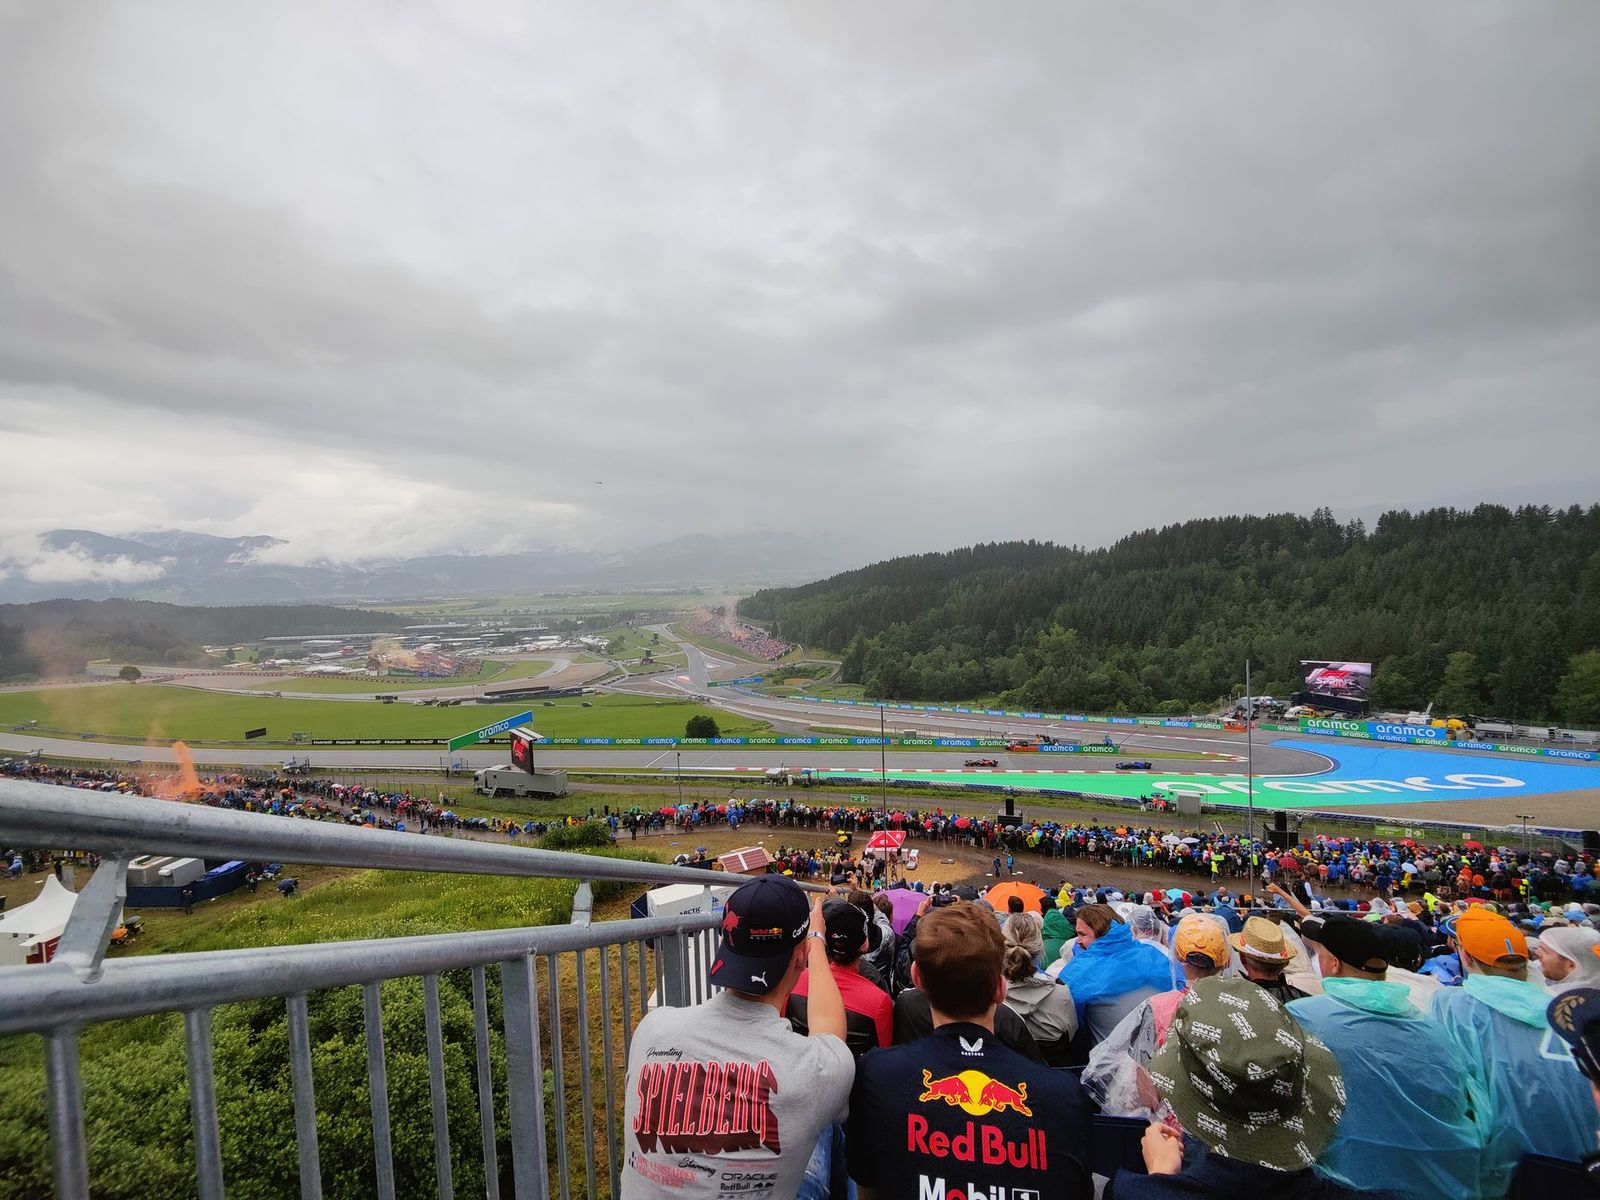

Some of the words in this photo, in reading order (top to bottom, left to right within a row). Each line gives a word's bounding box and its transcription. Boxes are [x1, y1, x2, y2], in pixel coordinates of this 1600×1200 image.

[1195, 722, 1221, 730] aramco
[1307, 719, 1359, 731] aramco
[478, 721, 510, 739] aramco
[1308, 728, 1335, 736] aramco
[1376, 724, 1436, 737] aramco
[1341, 731, 1370, 739] aramco
[1377, 734, 1407, 742] aramco
[1415, 738, 1448, 746] aramco
[1457, 741, 1493, 750] aramco
[1082, 745, 1114, 753] aramco
[1499, 744, 1538, 754] aramco
[1549, 750, 1591, 759] aramco
[1152, 774, 1526, 794] aramco
[645, 1047, 686, 1061] Presenting
[632, 1058, 772, 1146] SPIELBERG
[907, 1113, 975, 1162] Red
[981, 1125, 1048, 1170] Bull
[678, 1156, 716, 1177] Starring
[721, 1173, 779, 1181] ORACLE
[720, 1183, 736, 1191] Red
